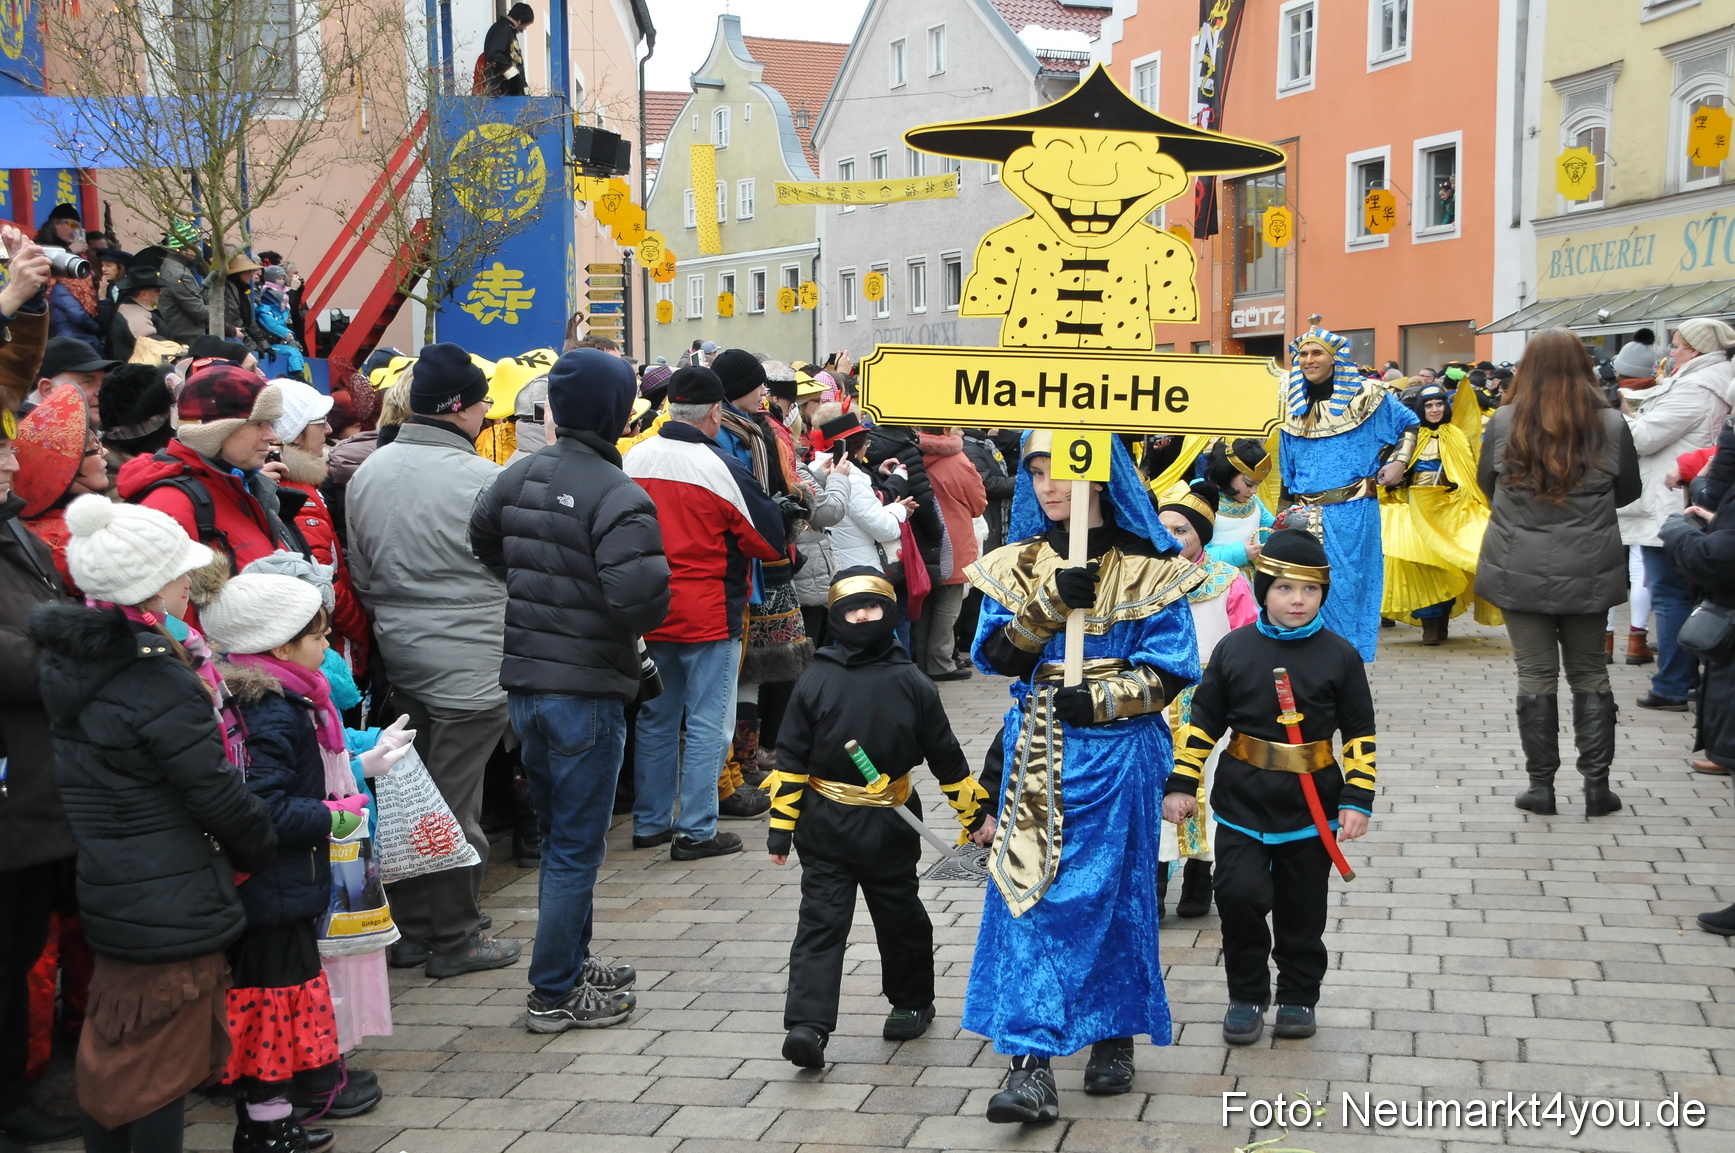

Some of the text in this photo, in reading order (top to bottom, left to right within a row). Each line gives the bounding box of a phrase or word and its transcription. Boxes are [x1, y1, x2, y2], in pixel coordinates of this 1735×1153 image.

[1549, 234, 1657, 279] BÄCKEREI
[1231, 305, 1285, 329] GÖTZ
[873, 326, 915, 346] OPTIK
[954, 369, 1190, 413] Ma-Hai-He
[1068, 439, 1093, 474] 9
